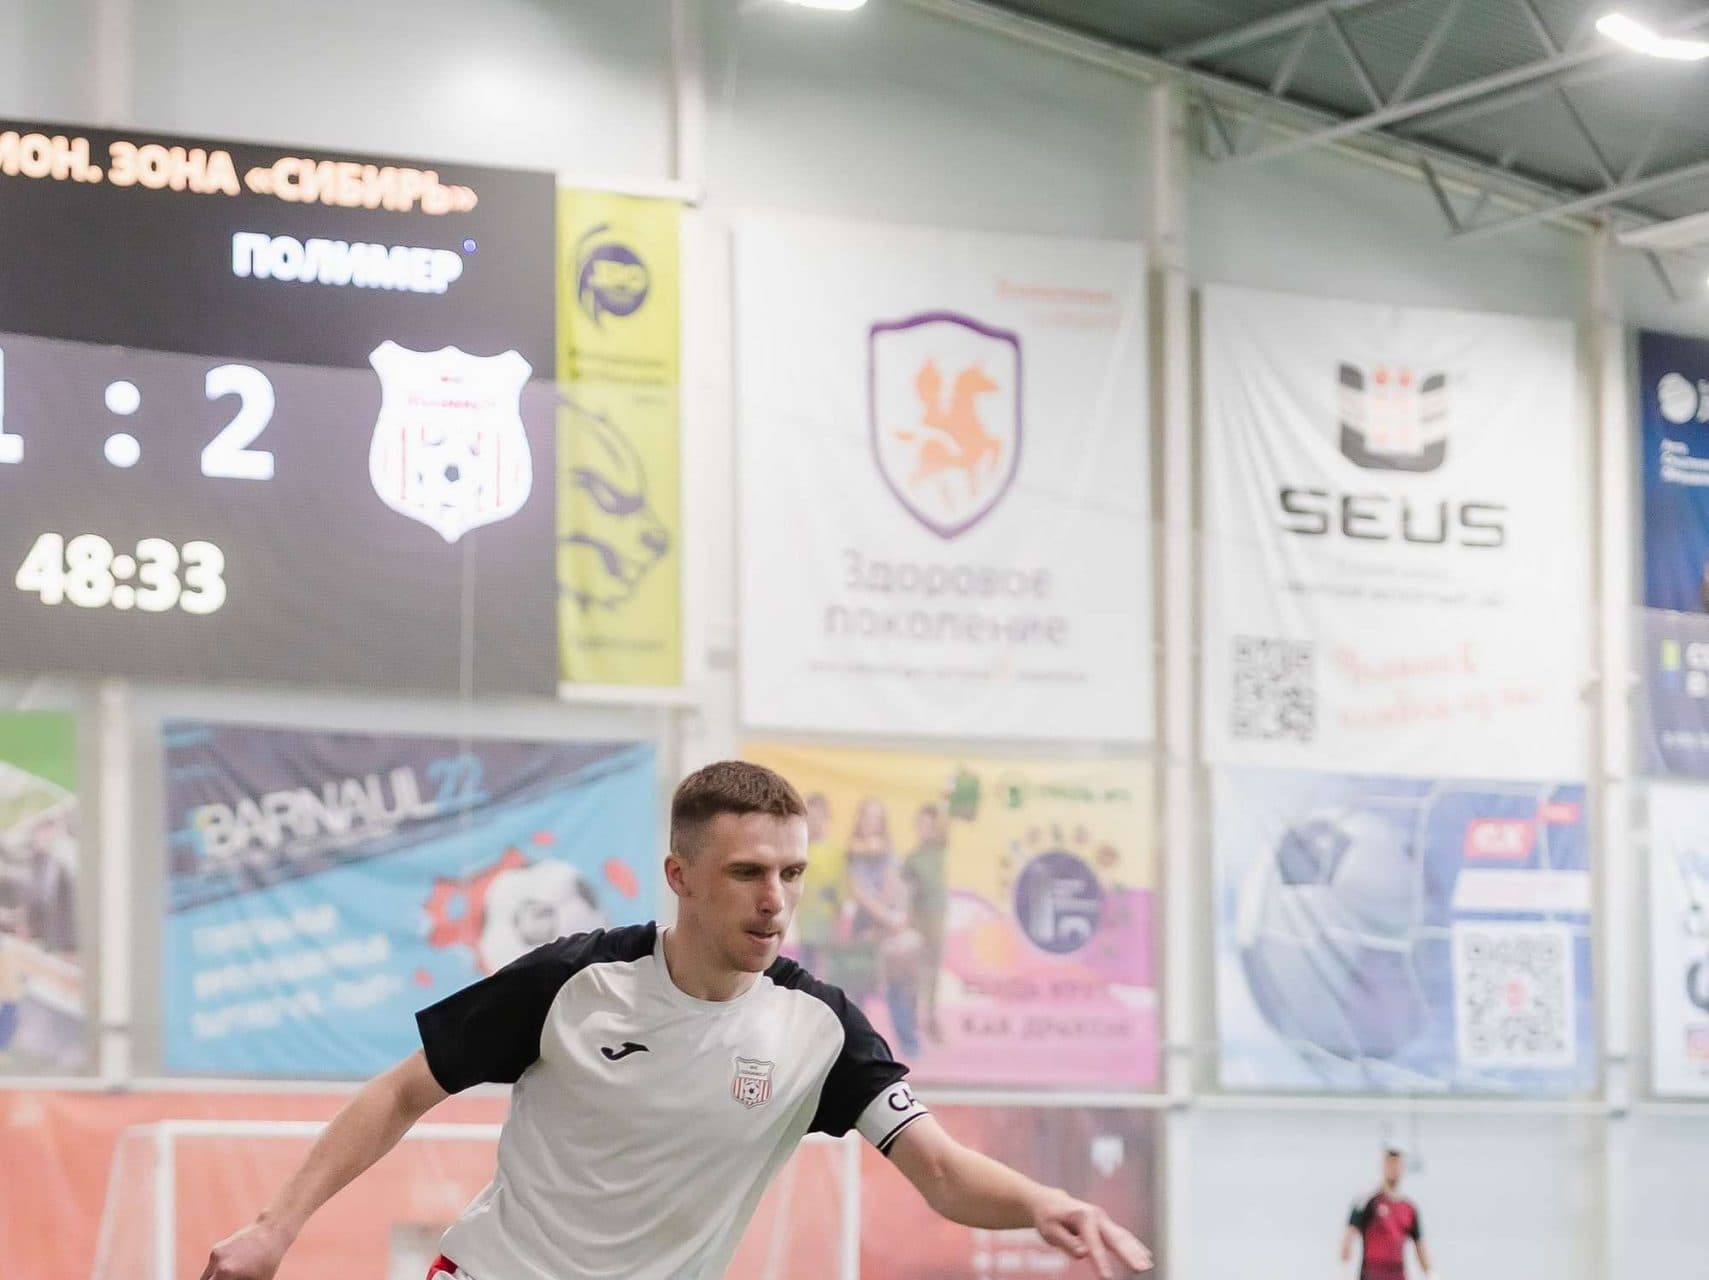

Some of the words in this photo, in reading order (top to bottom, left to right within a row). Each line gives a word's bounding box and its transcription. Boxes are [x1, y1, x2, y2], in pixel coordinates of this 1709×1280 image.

[108, 141, 241, 197] ЗОНА
[244, 157, 478, 215] «СИБИРЬ»
[232, 231, 463, 294] ПОЛИМЕР
[201, 364, 275, 480] 2
[1279, 486, 1508, 548] SEUS
[15, 532, 227, 614] 48:33
[842, 549, 1052, 599] Здоровое
[822, 602, 1070, 647] поколение
[196, 766, 438, 857] BARNAUL
